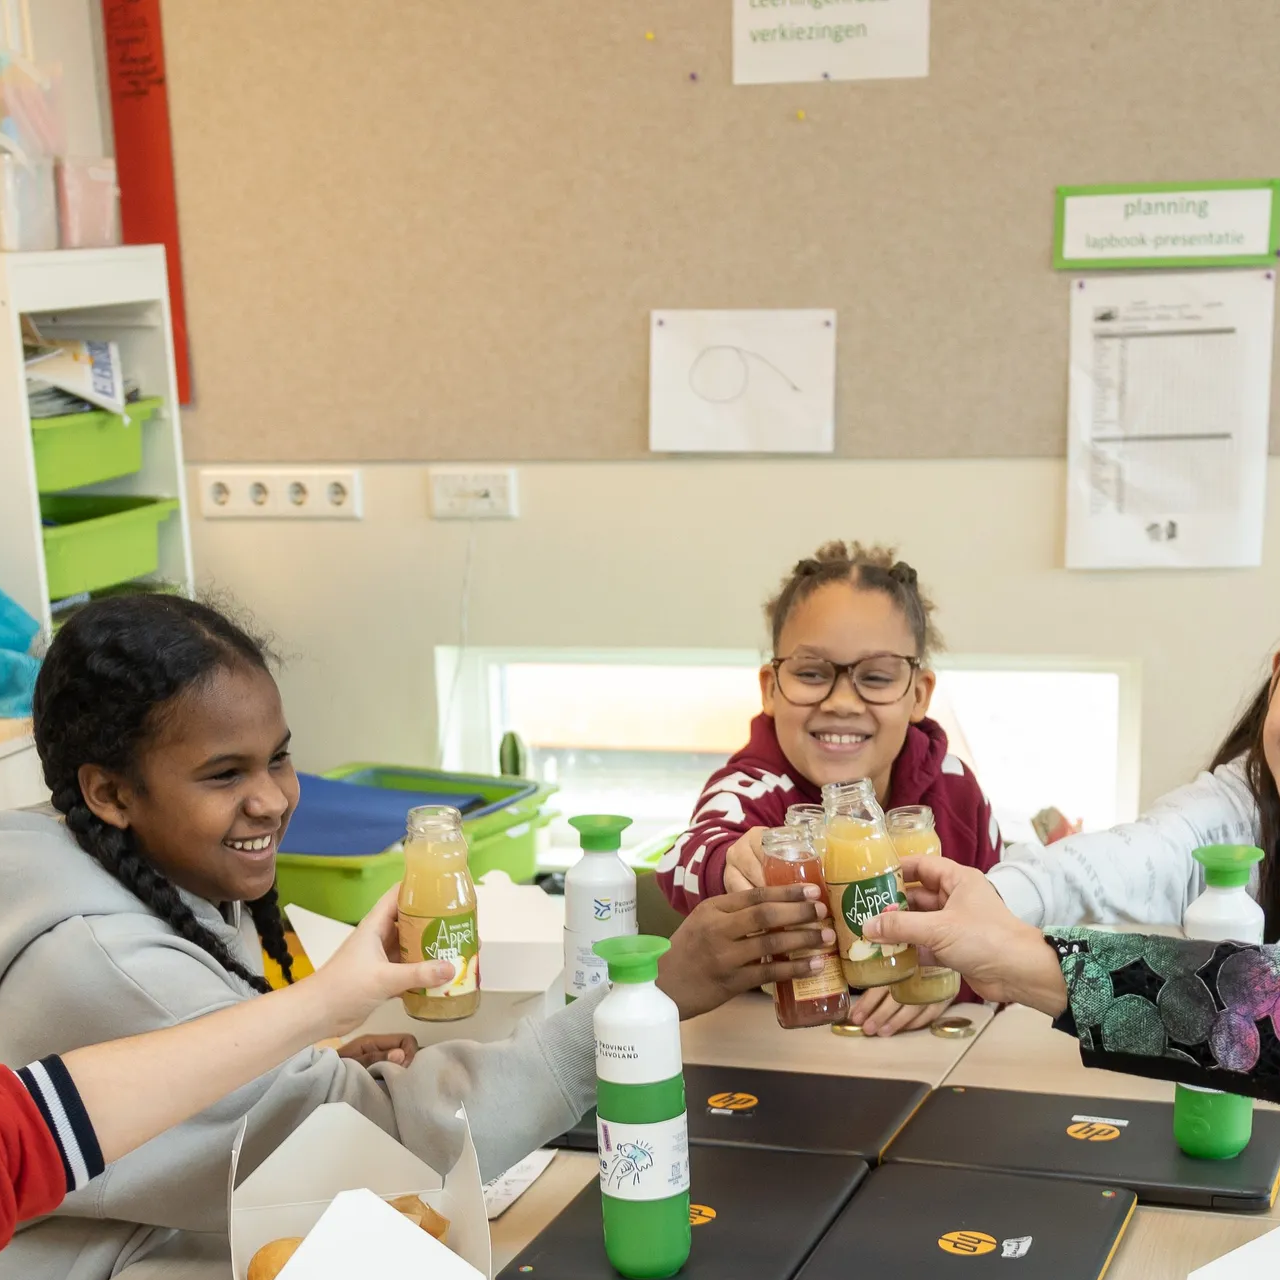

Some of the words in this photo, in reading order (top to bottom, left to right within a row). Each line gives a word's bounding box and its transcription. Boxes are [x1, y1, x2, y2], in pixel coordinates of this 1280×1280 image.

[749, 22, 868, 43] verkiezingen
[1123, 197, 1210, 220] planning
[1084, 229, 1245, 250] lapbook-presentatie
[854, 879, 895, 914] Appel
[436, 917, 475, 954] Appel
[600, 1040, 635, 1052] PROVINCIE
[600, 1049, 639, 1059] FLEVOLAND
[707, 1092, 758, 1109] hp
[1066, 1122, 1120, 1141] hp
[938, 1231, 997, 1256] hp
